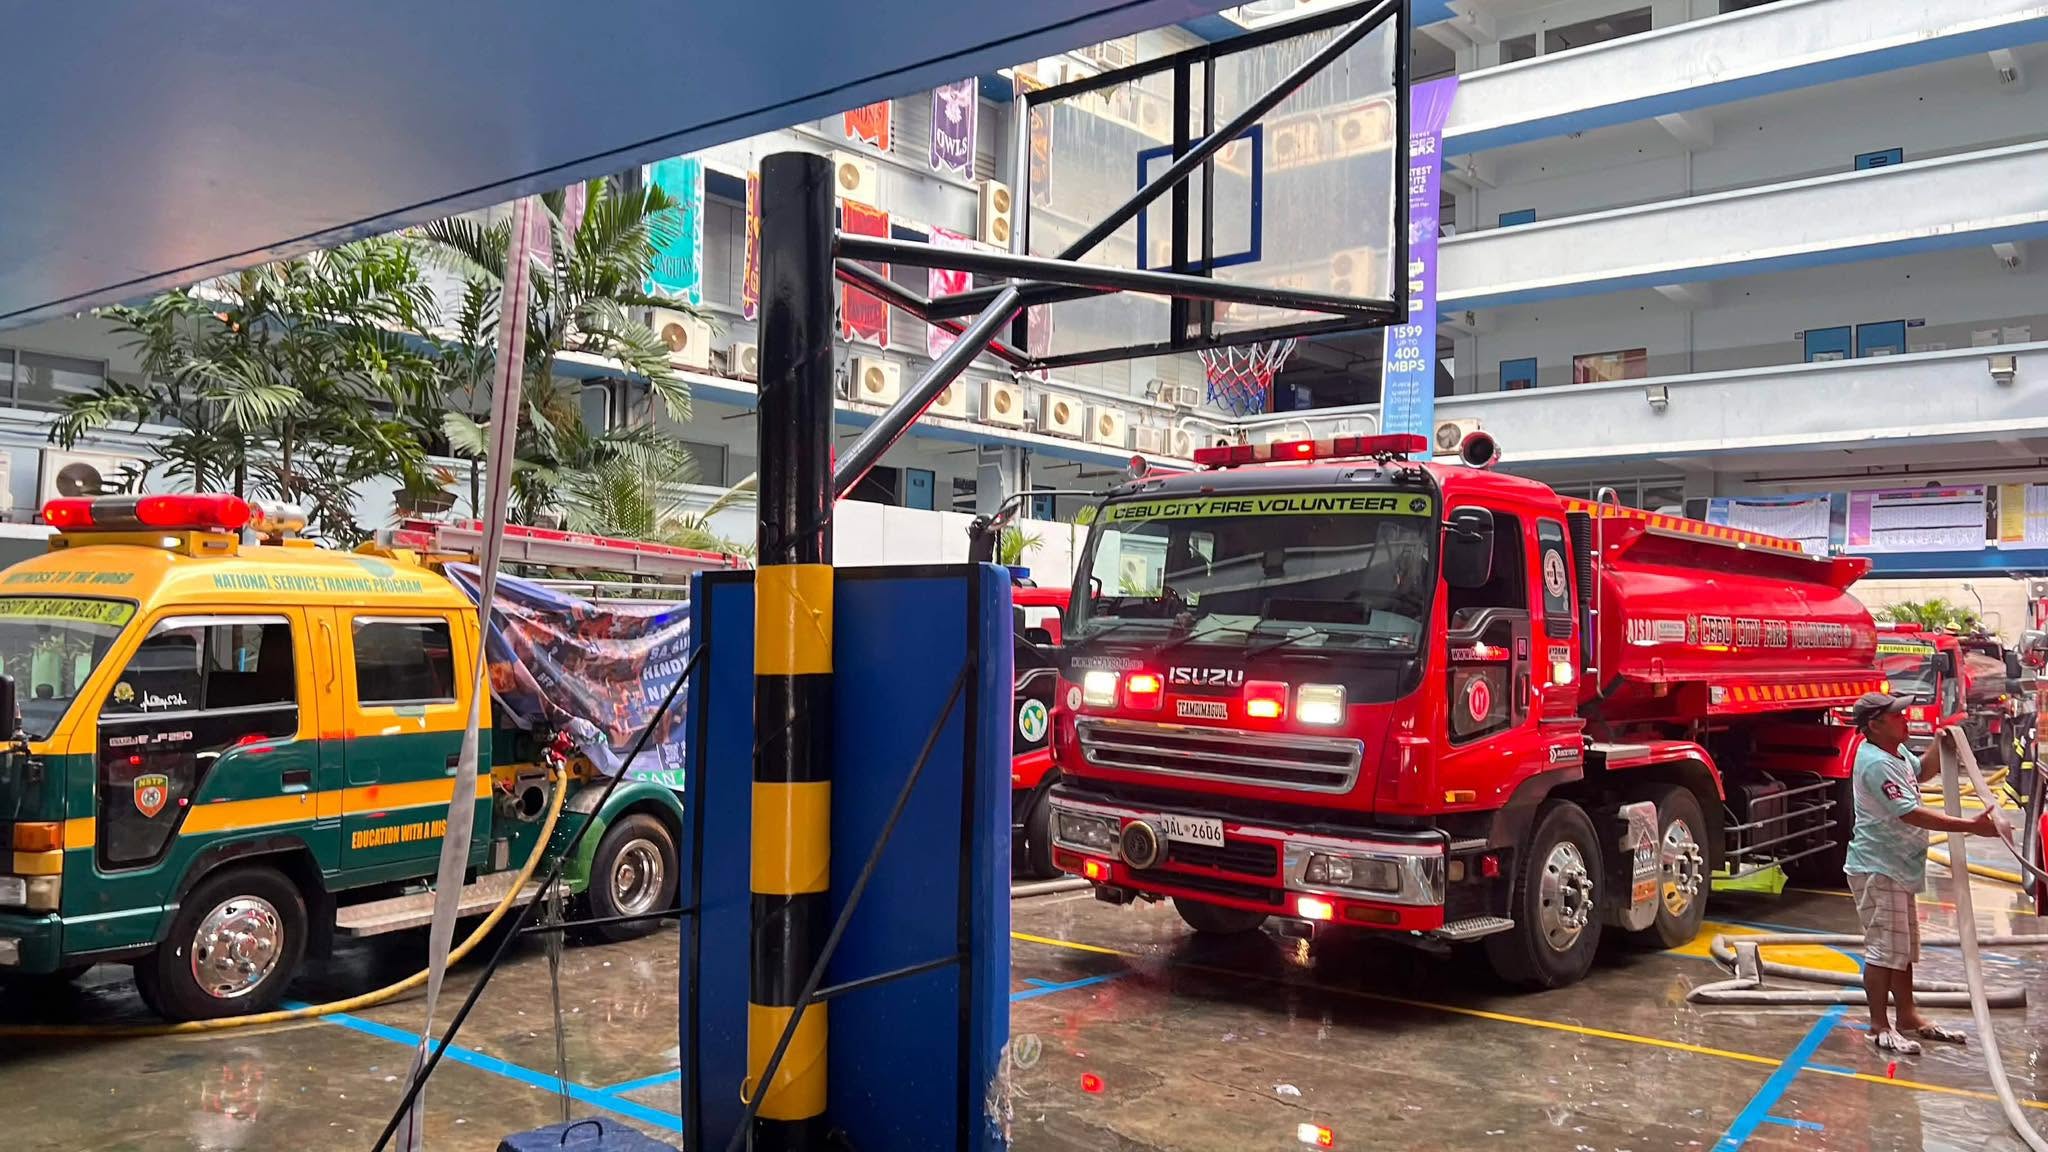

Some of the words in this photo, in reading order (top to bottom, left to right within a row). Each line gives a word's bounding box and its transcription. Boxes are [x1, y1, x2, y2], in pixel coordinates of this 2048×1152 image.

[936, 128, 967, 155] OWLS
[1394, 326, 1422, 339] 1599
[1394, 347, 1420, 359] 400
[1388, 360, 1425, 373] MBPS
[1113, 503, 1161, 518] CEBU
[1163, 501, 1208, 516] CITY
[1210, 499, 1254, 514] FIRE
[1258, 497, 1398, 512] VOLUNTEER
[213, 573, 270, 590] NATIONAL
[272, 575, 321, 591] SERVICE
[321, 577, 372, 592] TRAINING
[374, 579, 423, 593] PROGRAM
[1701, 616, 1732, 645] CEBU
[1736, 618, 1760, 646] CITY
[1763, 620, 1788, 647] FIRE
[1168, 666, 1244, 688] ISUZU
[351, 826, 400, 850] EDUCATION
[400, 822, 423, 842] WITH
[423, 821, 430, 839] A
[431, 819, 448, 837] MIS
[1163, 819, 1184, 837] JAL
[1190, 823, 1221, 841] 2606
